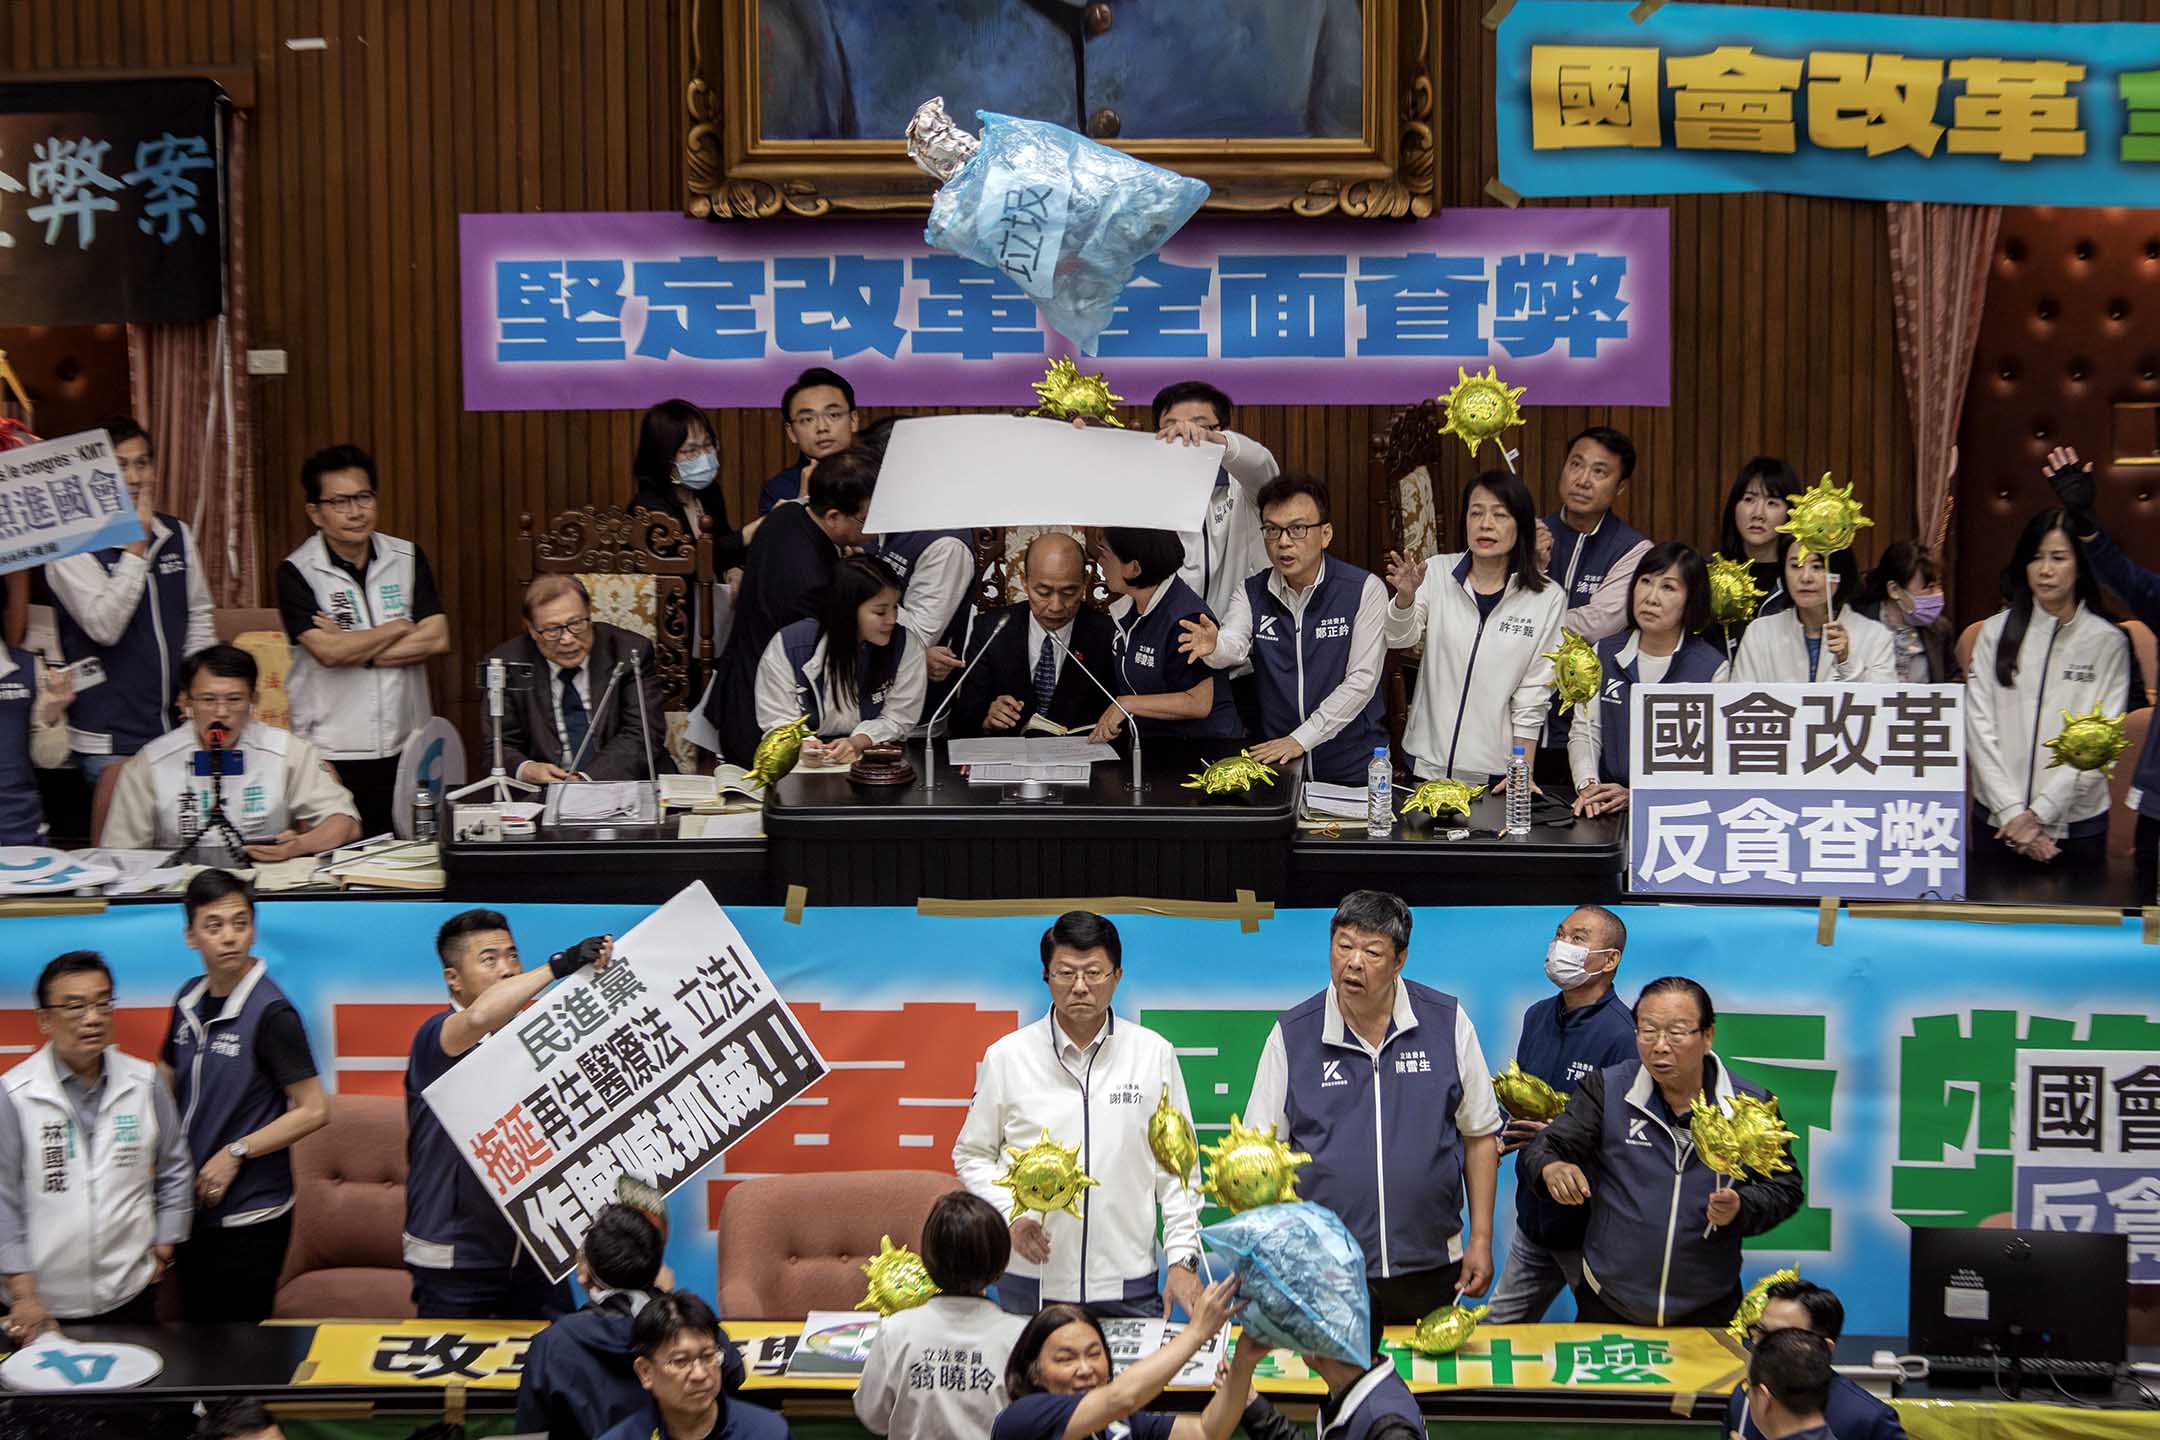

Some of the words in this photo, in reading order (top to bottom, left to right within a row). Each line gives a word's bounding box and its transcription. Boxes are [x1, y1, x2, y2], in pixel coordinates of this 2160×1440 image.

[1531, 45, 2087, 162] 國會改革
[0, 131, 215, 251] 弊案
[1000, 187, 1053, 283] 垃圾
[496, 255, 1045, 362] 堅定改革
[1081, 251, 1629, 359] 全面查弊
[1643, 691, 1960, 779] 國會改革
[1637, 797, 1962, 888] 反貪查弊
[517, 956, 648, 1073] 民進黨
[472, 1007, 689, 1196] 拖延再生醫療法
[1109, 1091, 1144, 1105] 謝龍介
[373, 1333, 530, 1380] 改
[1382, 1334, 1674, 1386] 什麼
[911, 1363, 997, 1396] 翁曉玲
[922, 1347, 983, 1364] 立法委員
